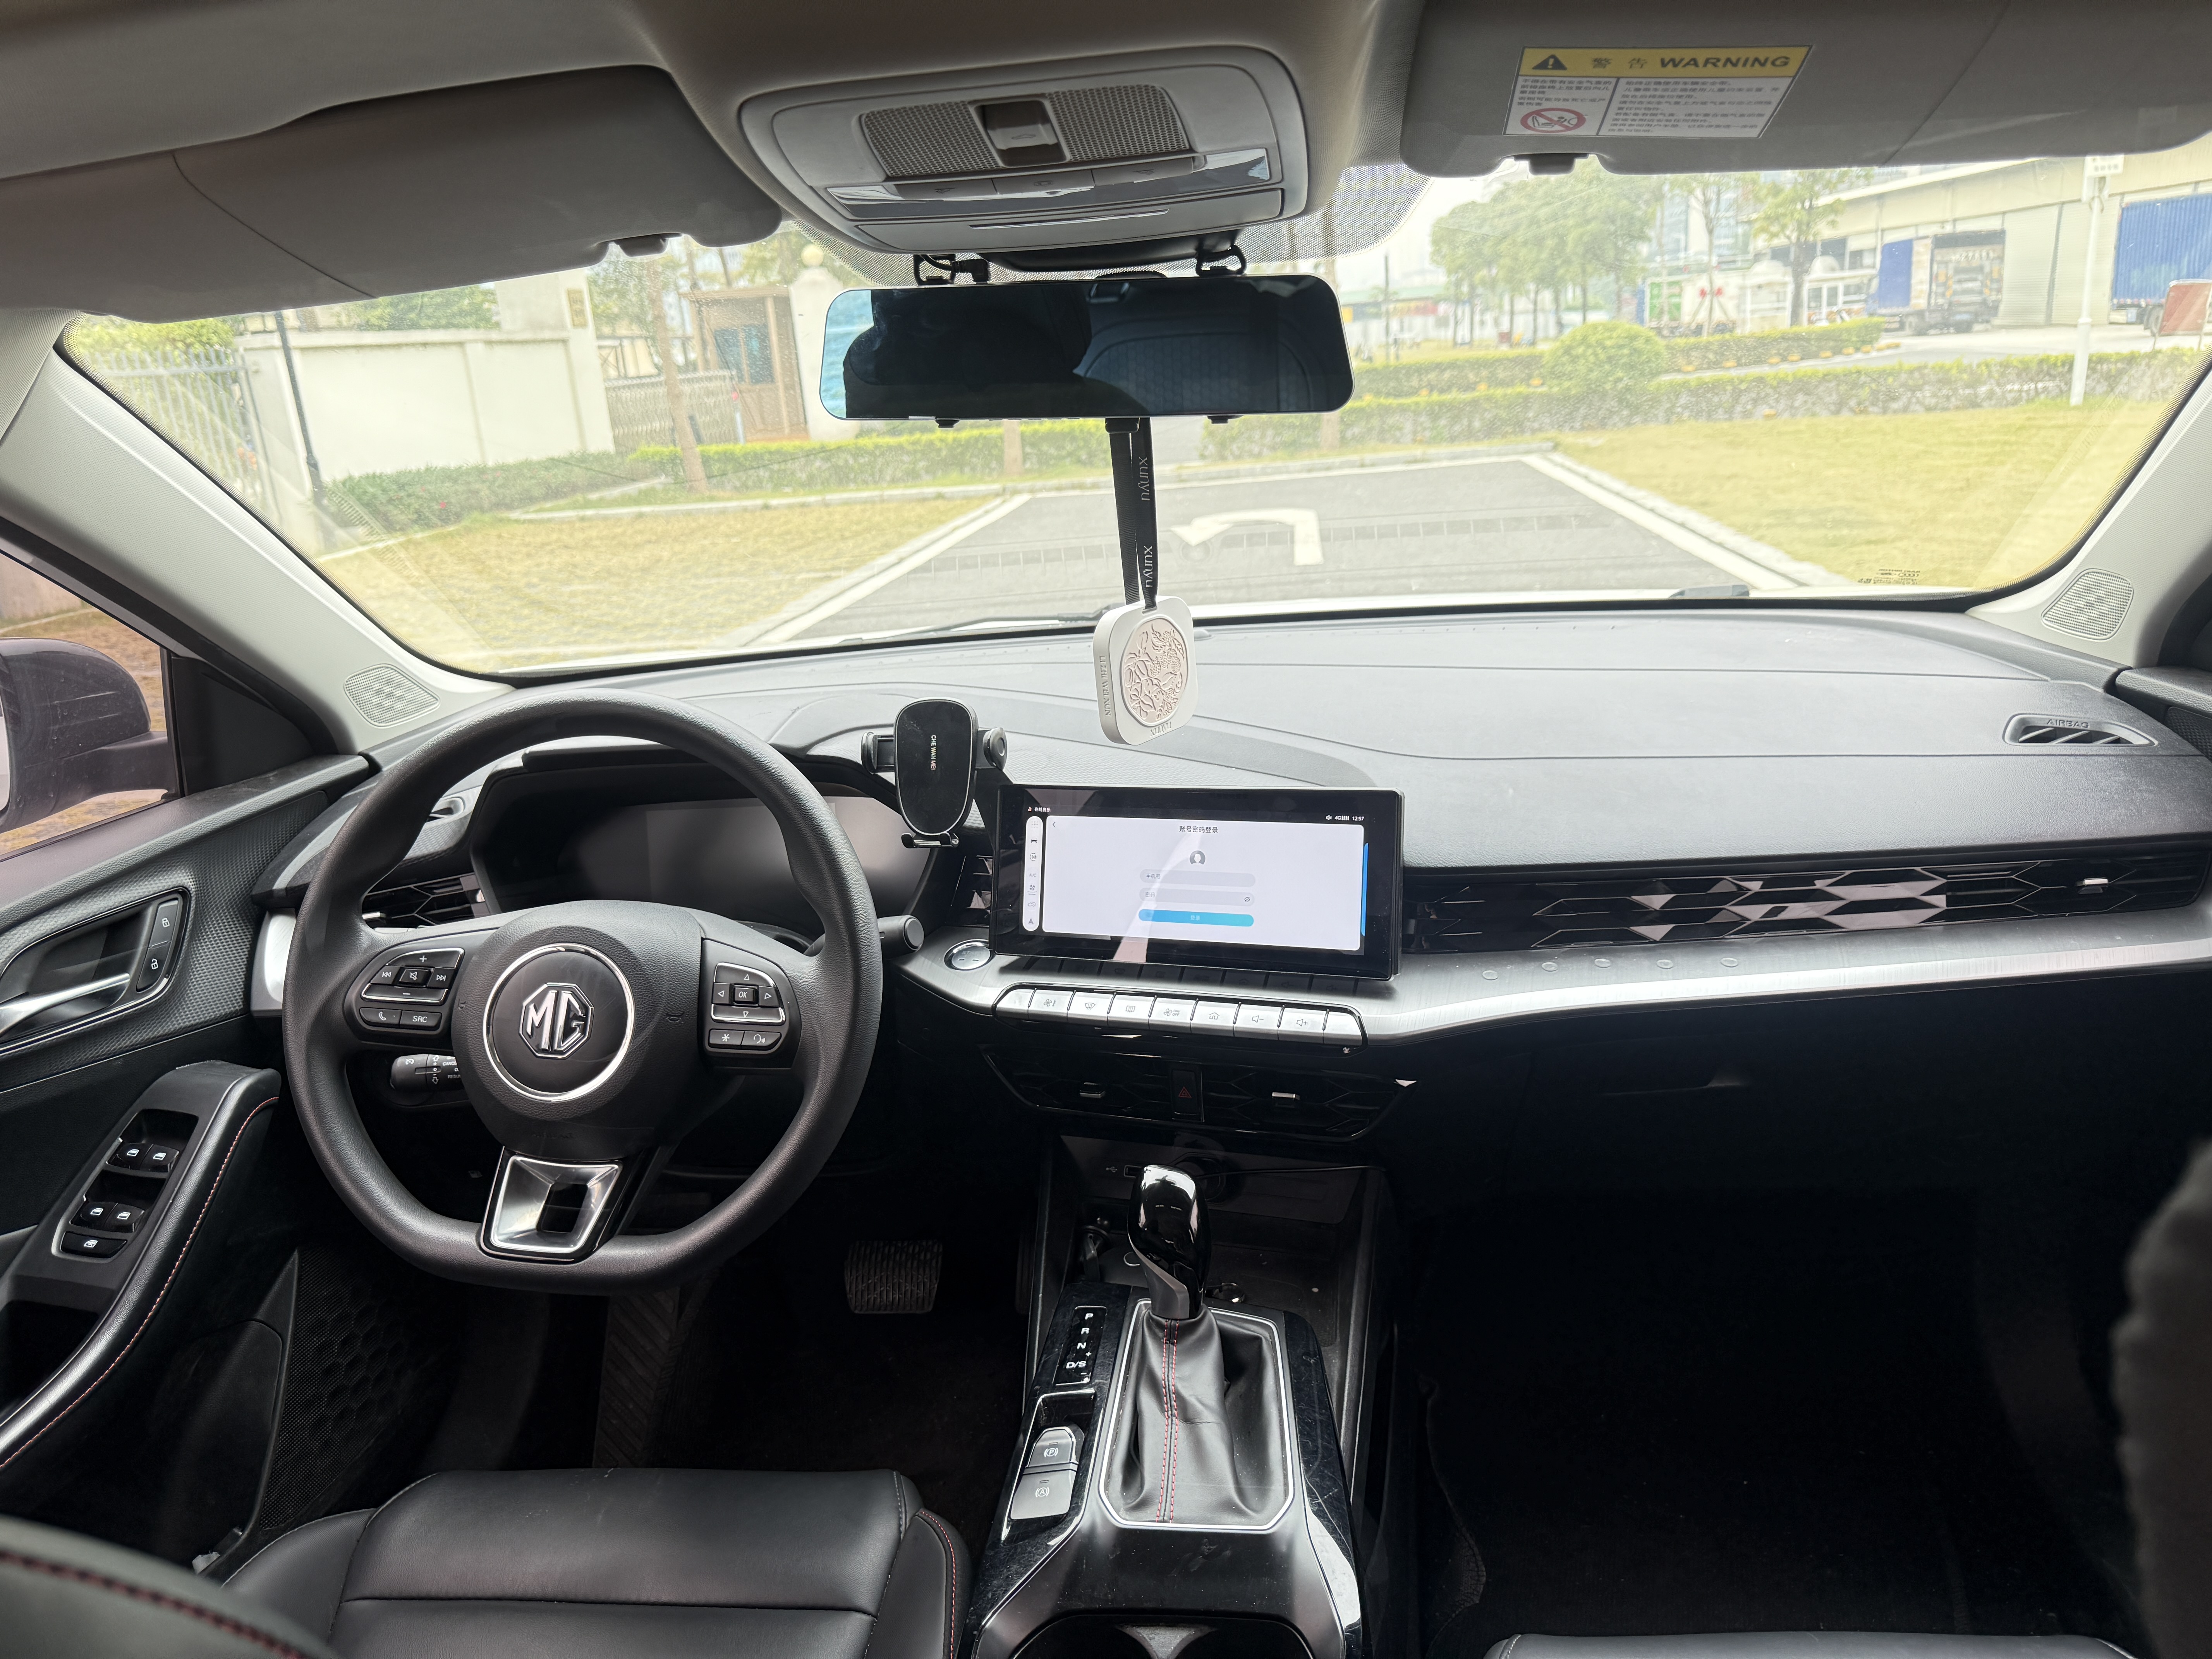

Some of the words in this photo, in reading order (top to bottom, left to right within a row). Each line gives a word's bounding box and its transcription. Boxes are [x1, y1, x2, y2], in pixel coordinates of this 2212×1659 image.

[1660, 56, 1791, 68] WARNING
[1138, 457, 1150, 501] xunyu
[1143, 546, 1153, 587] xunyu
[2047, 719, 2090, 728] AIRBAG
[526, 990, 585, 1052] MG
